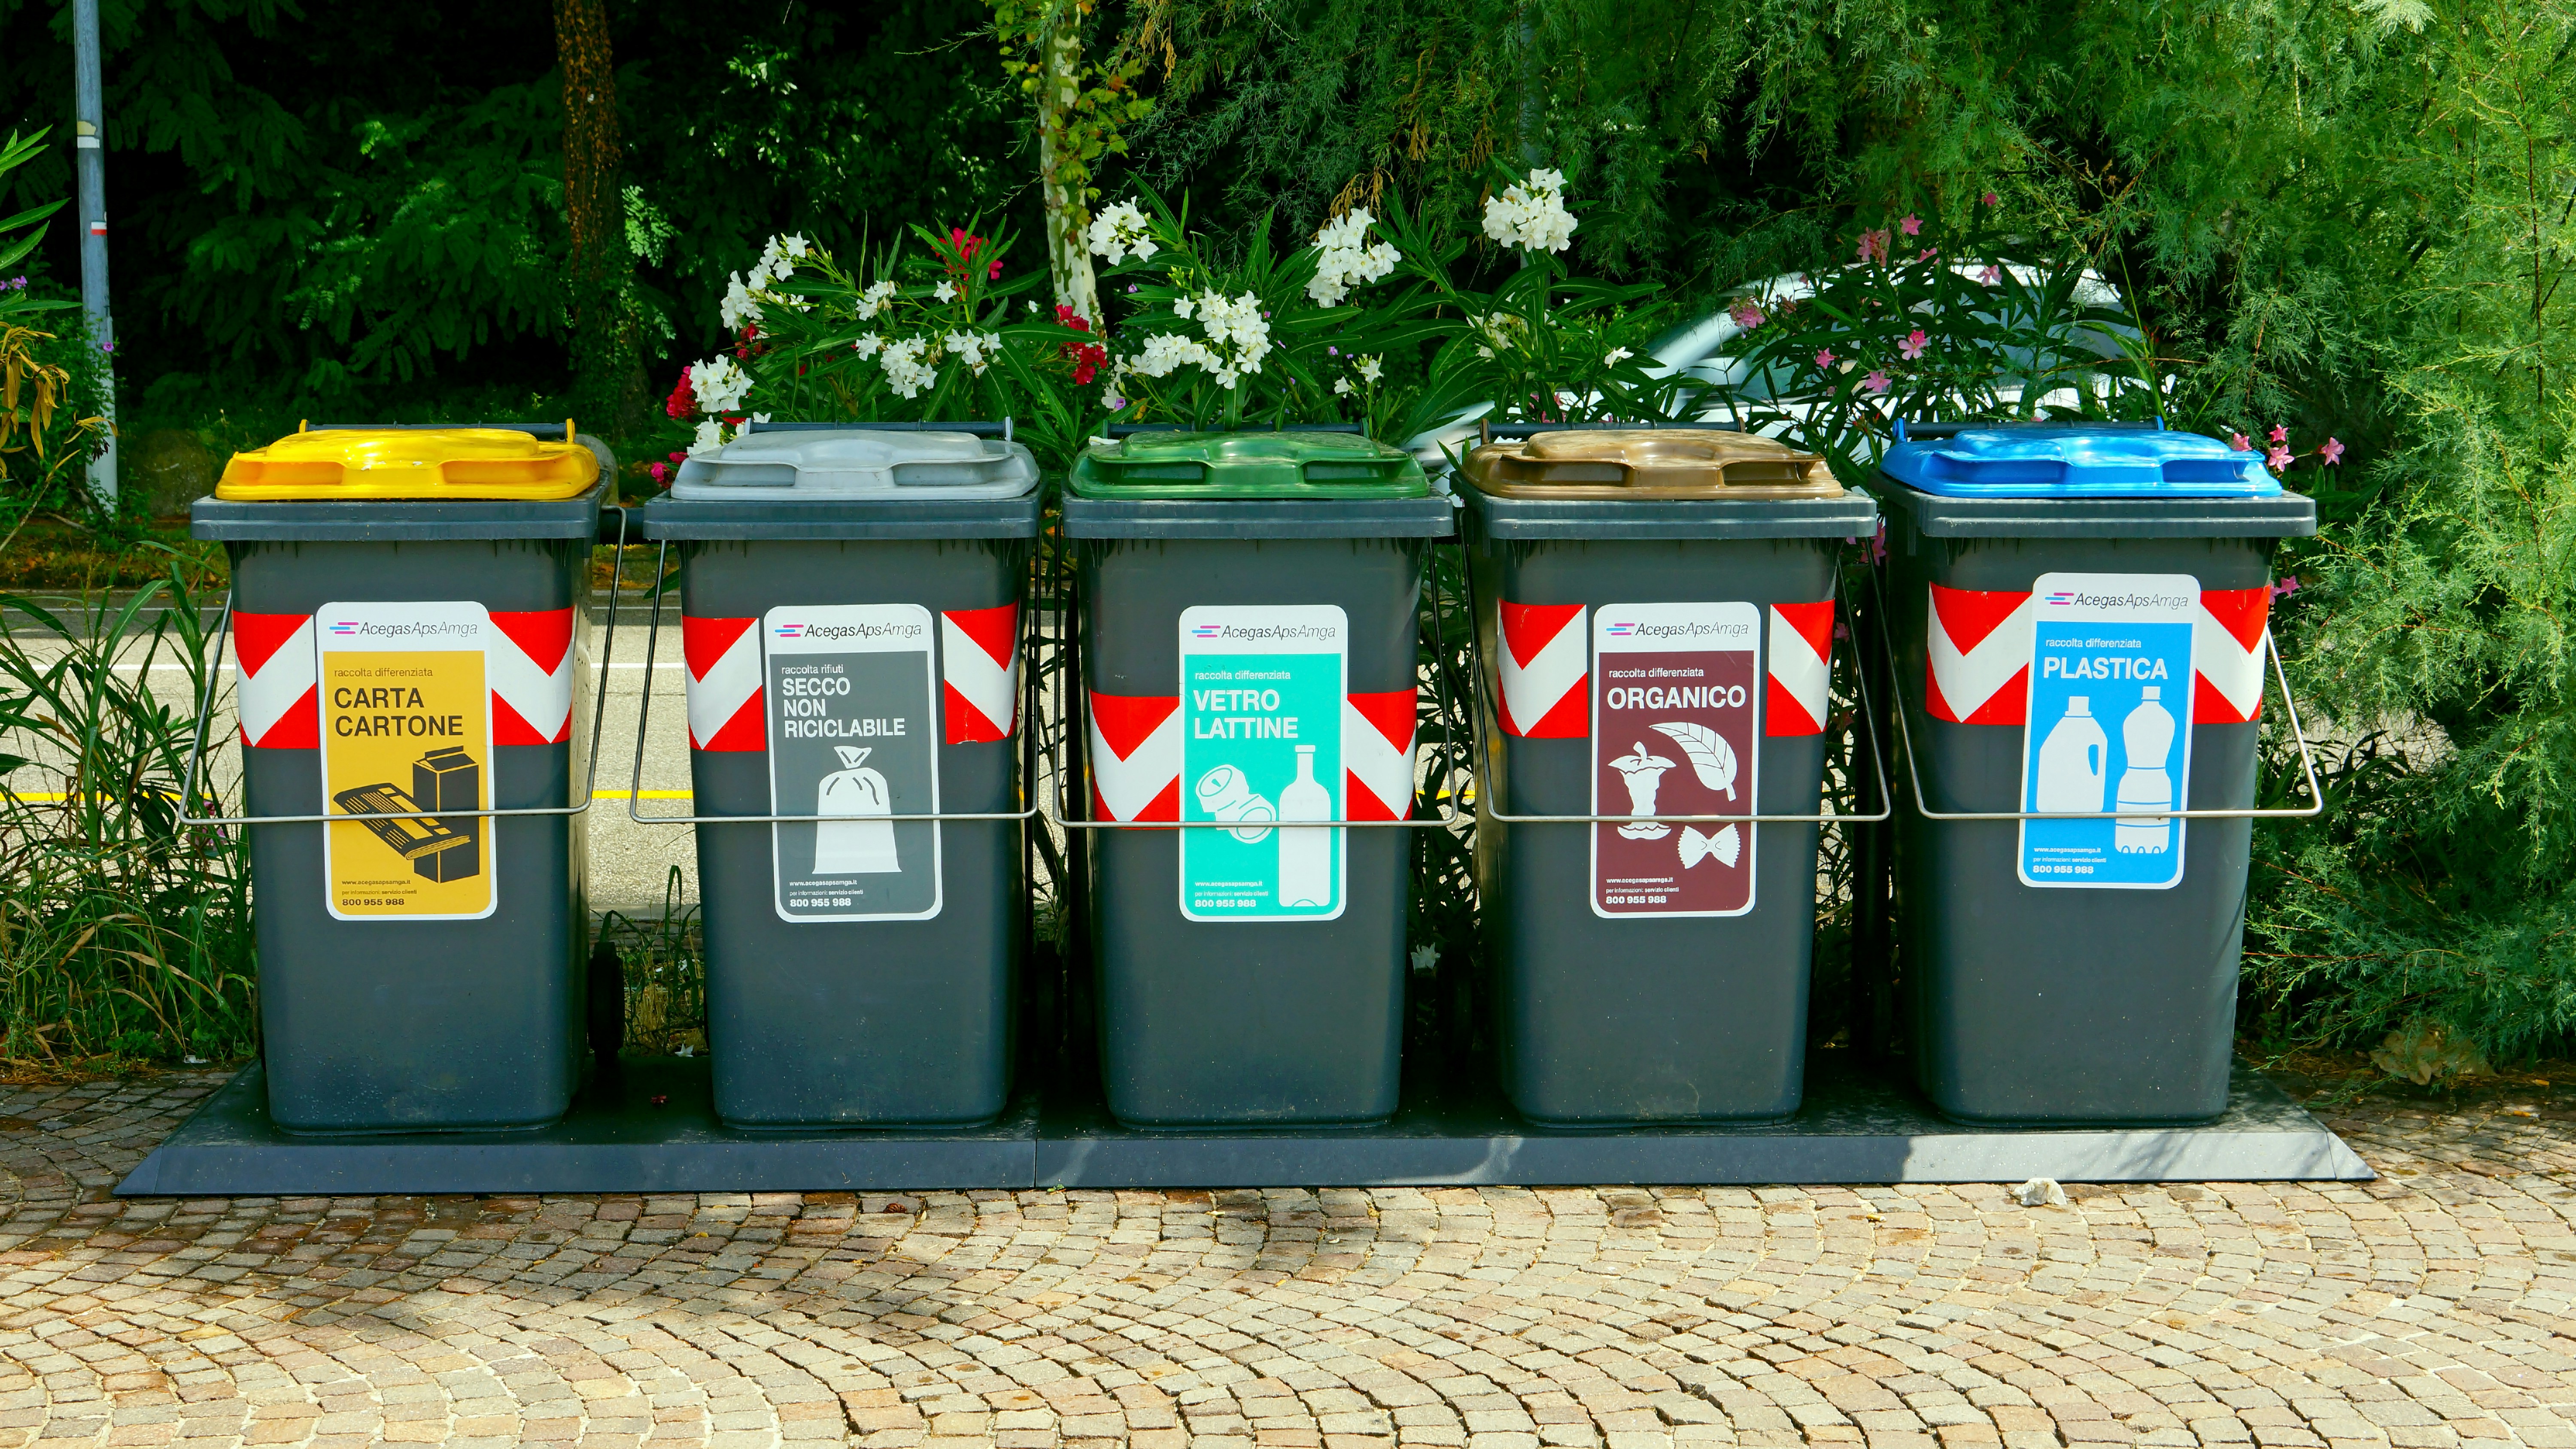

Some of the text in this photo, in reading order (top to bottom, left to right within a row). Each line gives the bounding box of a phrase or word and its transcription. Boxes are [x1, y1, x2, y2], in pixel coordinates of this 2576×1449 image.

[2074, 593, 2188, 610] AcegasApsAmga
[360, 622, 477, 637] AcegasApsAmga
[805, 623, 921, 640] AcegasApsAmga
[1221, 624, 1335, 640] AcegasApsAmga
[1635, 622, 1748, 638] AcegasApsAmga
[2046, 638, 2141, 648] raccolta differenziata
[334, 668, 433, 677] raccolta differenziata
[782, 664, 844, 674] raccolta rifiuti
[1195, 670, 1291, 679] raccolta differenziata
[1609, 667, 1704, 678] raccolta differenziata
[2043, 657, 2168, 679] PLASTICA
[782, 677, 850, 696] SECCO
[334, 688, 424, 708] CARTA
[1193, 689, 1280, 711] VETRO
[1607, 685, 1746, 709] ORGANICO
[784, 699, 826, 717] NON
[335, 715, 463, 737] CARTONE
[784, 718, 905, 738] RICICLABILE
[1195, 717, 1298, 739] LATTINE
[790, 898, 851, 907] 800 955 988
